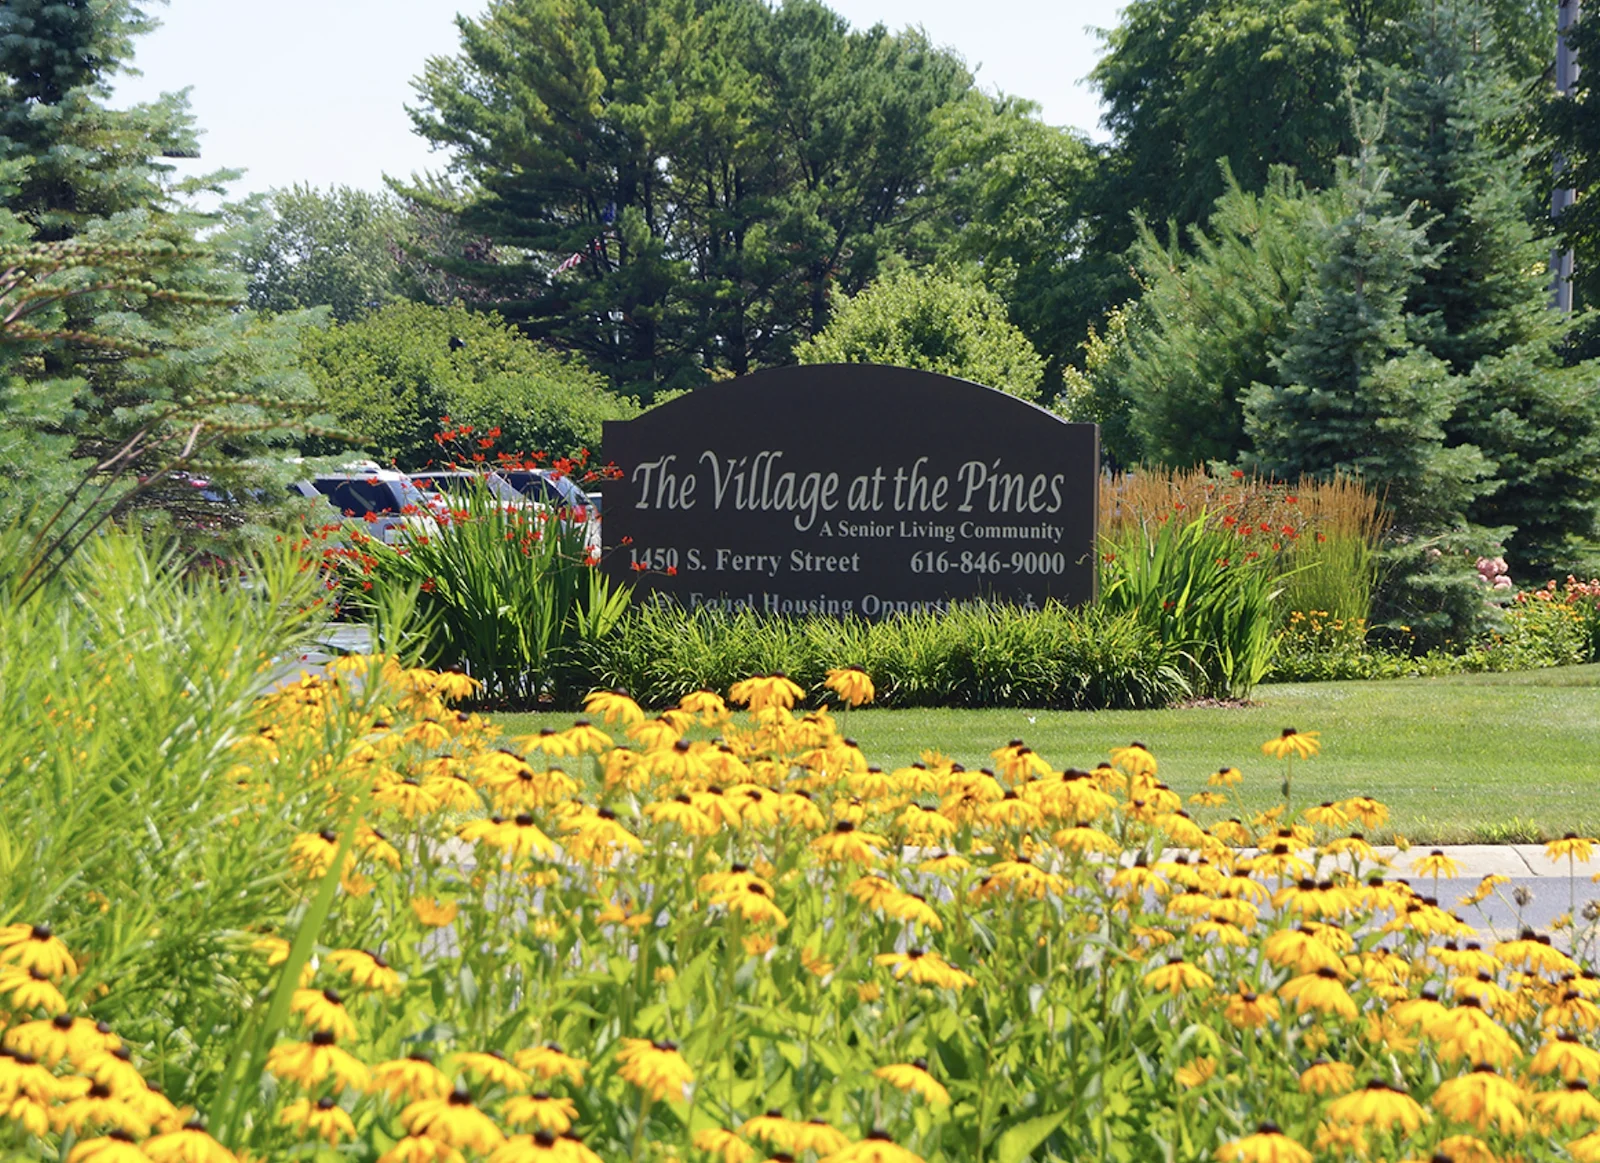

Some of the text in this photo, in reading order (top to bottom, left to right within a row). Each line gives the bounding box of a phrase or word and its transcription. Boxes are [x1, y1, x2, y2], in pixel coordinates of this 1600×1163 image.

[632, 451, 1064, 531] The Village at the Pines
[820, 521, 1064, 543] A Senior Living Community
[630, 547, 1065, 577] 1450 S. Ferry Street 616-846-9000
[764, 593, 853, 617] Housing
